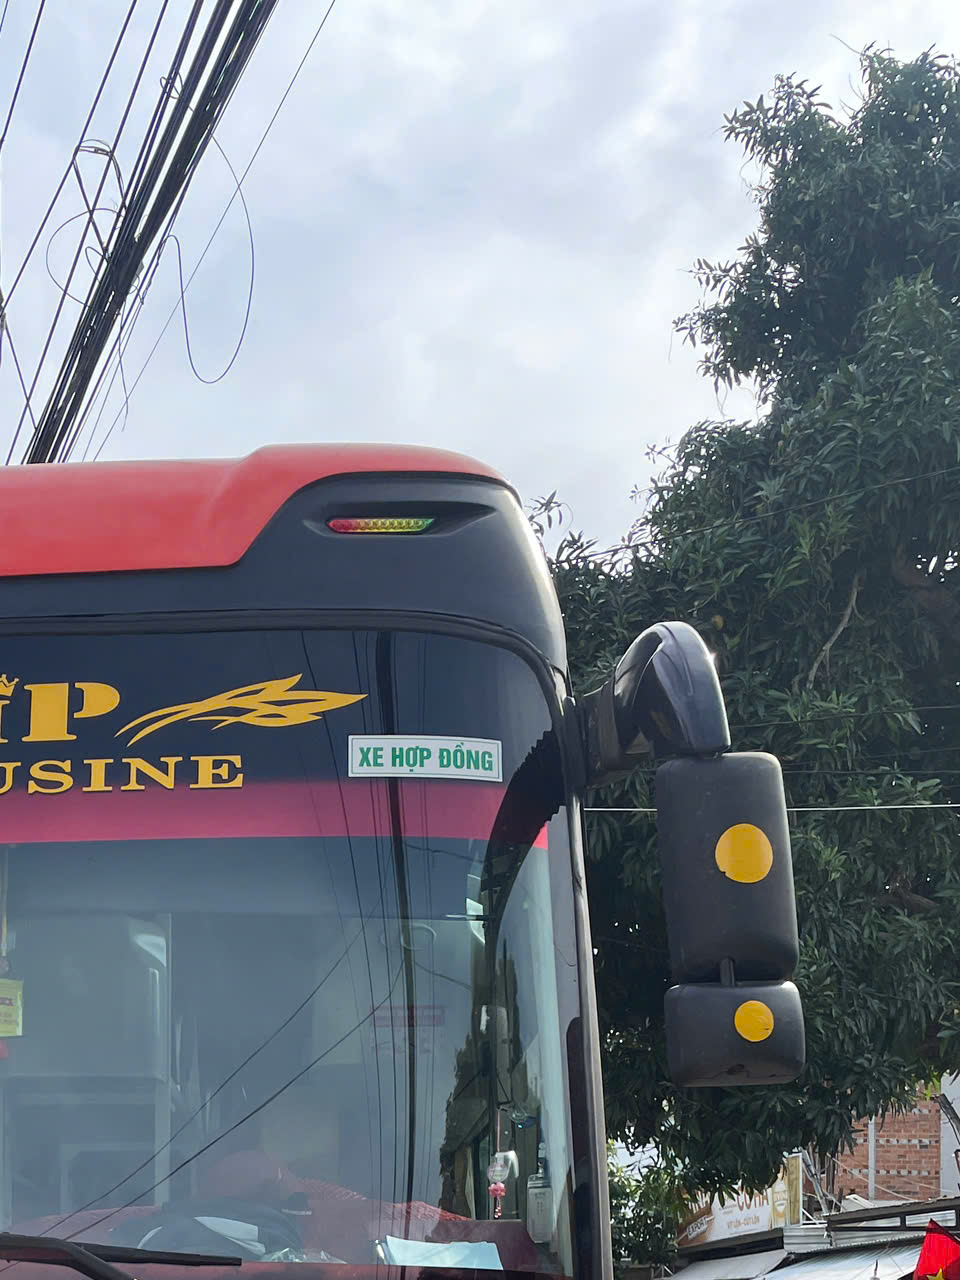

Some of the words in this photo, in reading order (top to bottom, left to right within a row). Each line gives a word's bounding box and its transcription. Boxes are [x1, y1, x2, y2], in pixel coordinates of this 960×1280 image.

[359, 747, 384, 767] XE
[392, 746, 432, 772] HỢP
[438, 742, 493, 771] ĐỒNG
